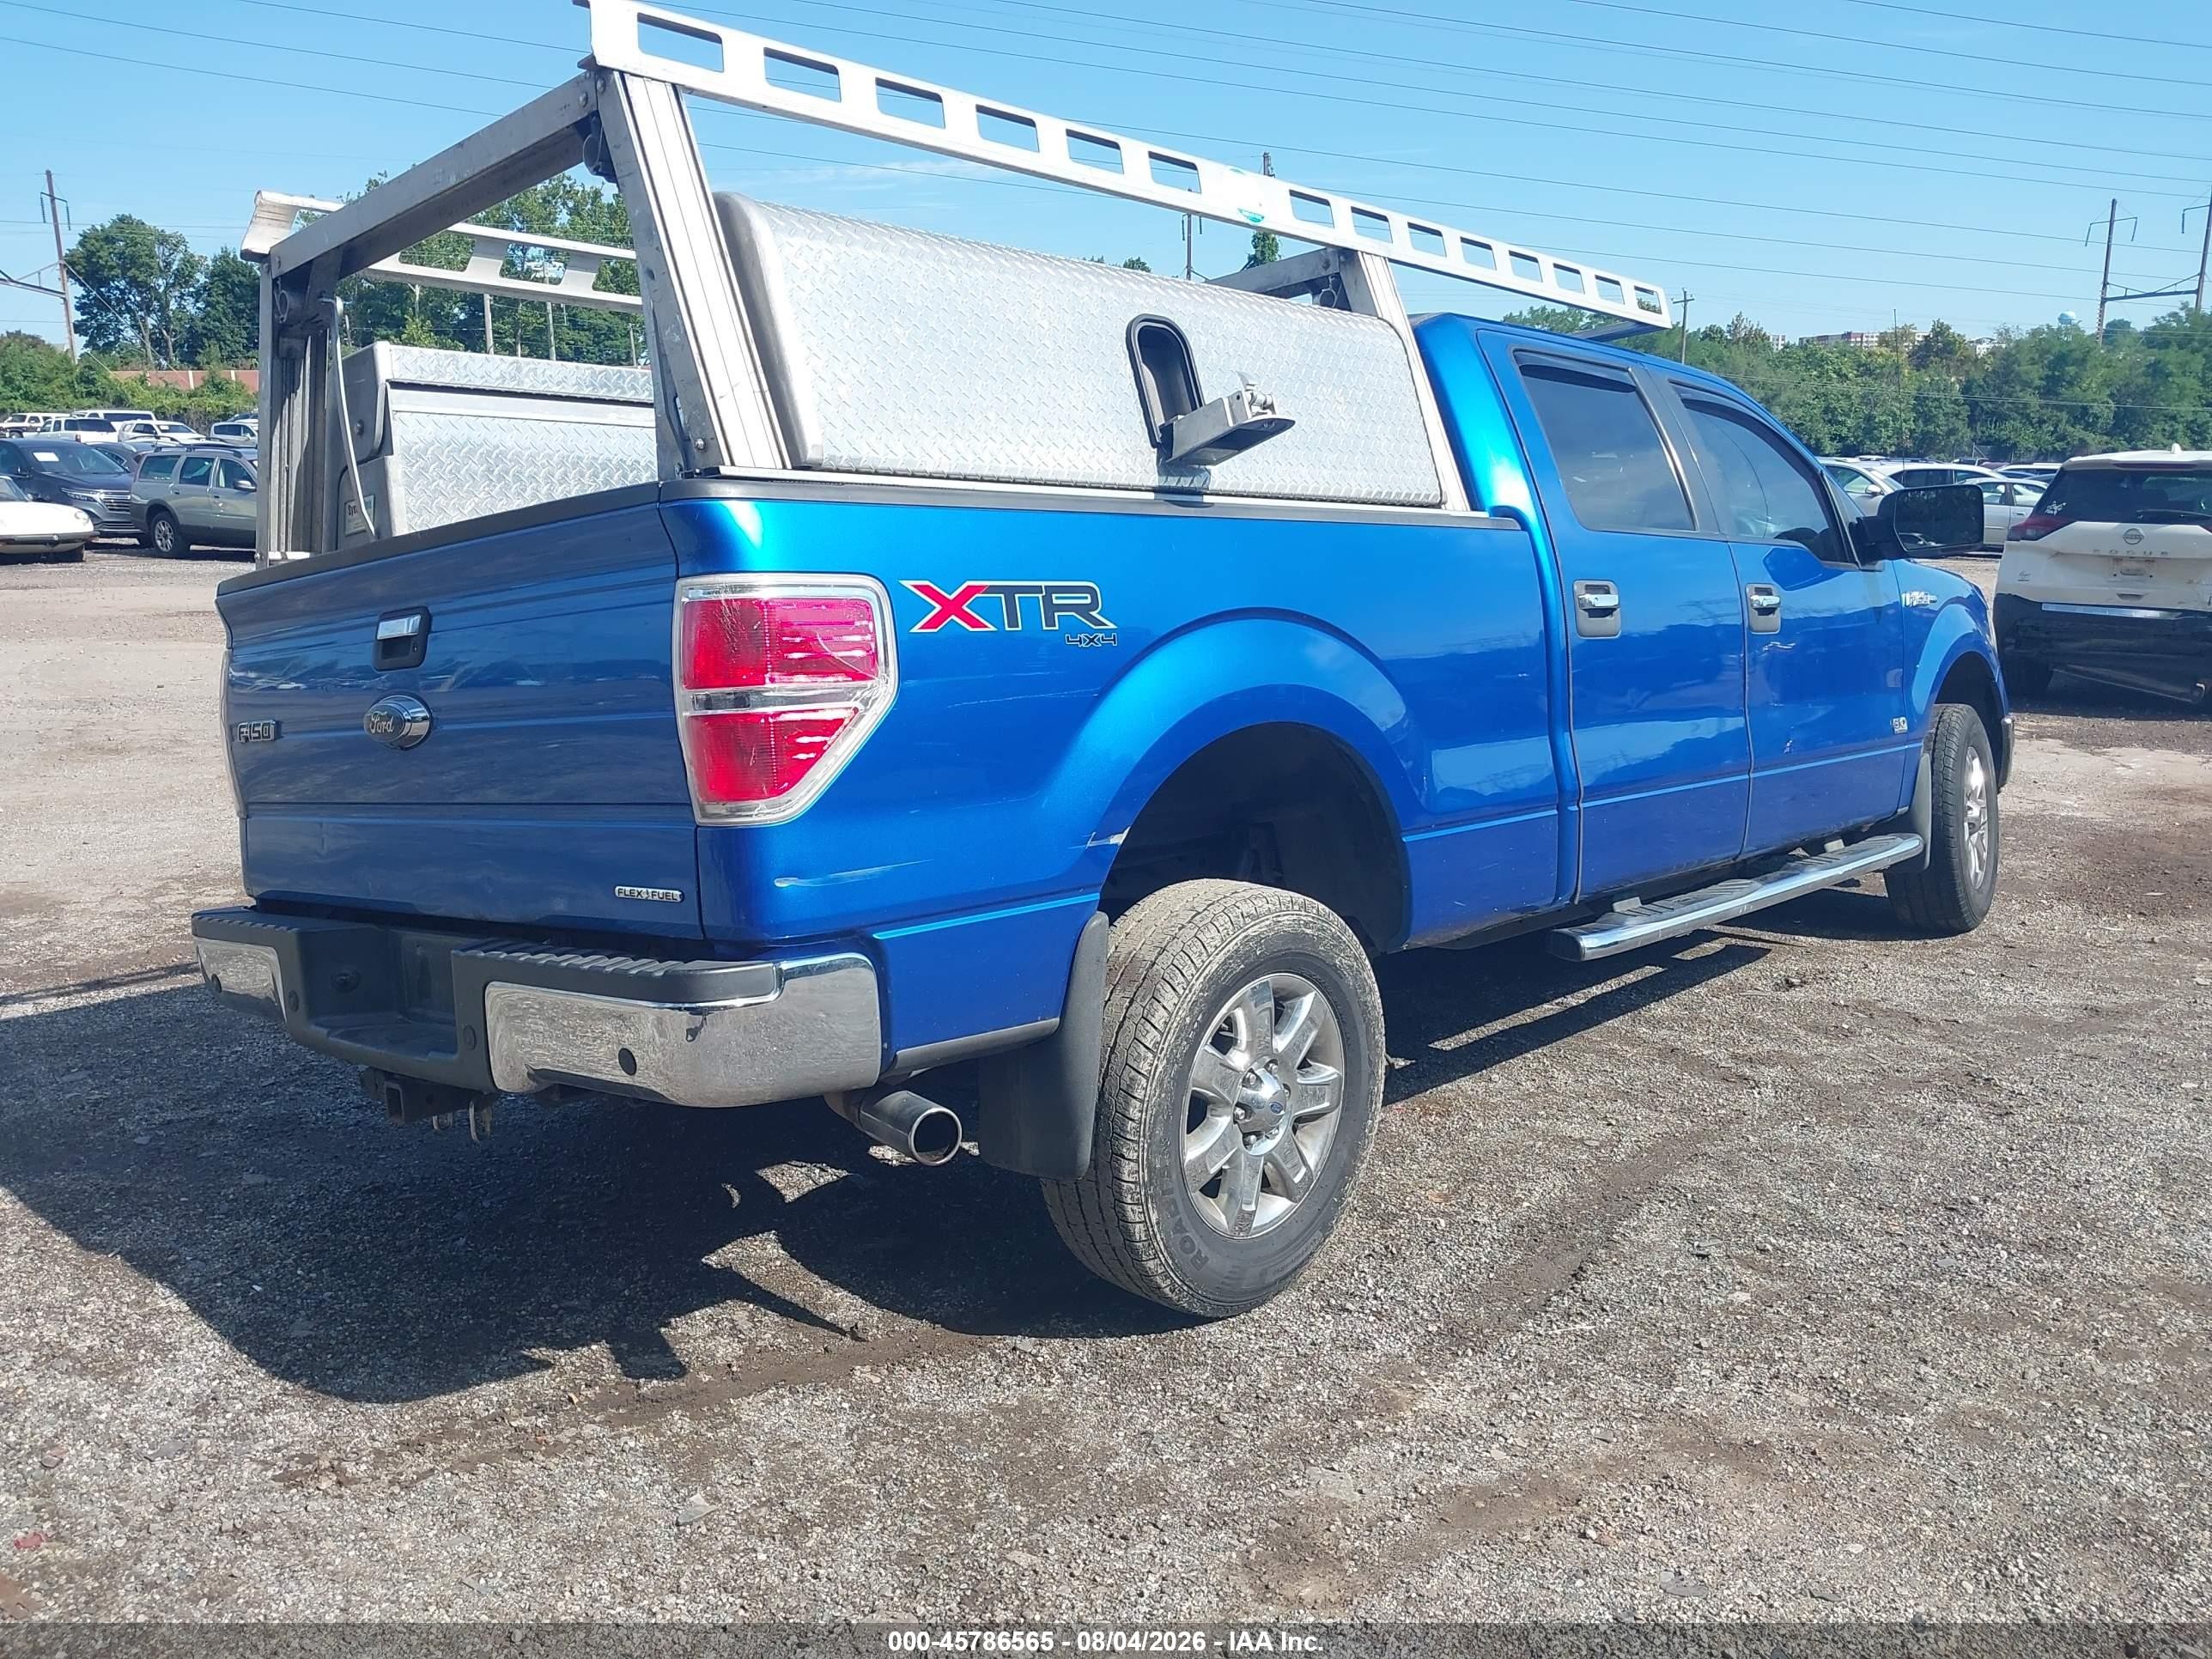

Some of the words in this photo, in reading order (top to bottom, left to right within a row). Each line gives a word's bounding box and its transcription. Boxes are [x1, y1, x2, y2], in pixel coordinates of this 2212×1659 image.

[899, 580, 1117, 632] XTR
[369, 711, 394, 734] Ford
[617, 888, 643, 898] FLEX
[651, 890, 678, 901] FUEL
